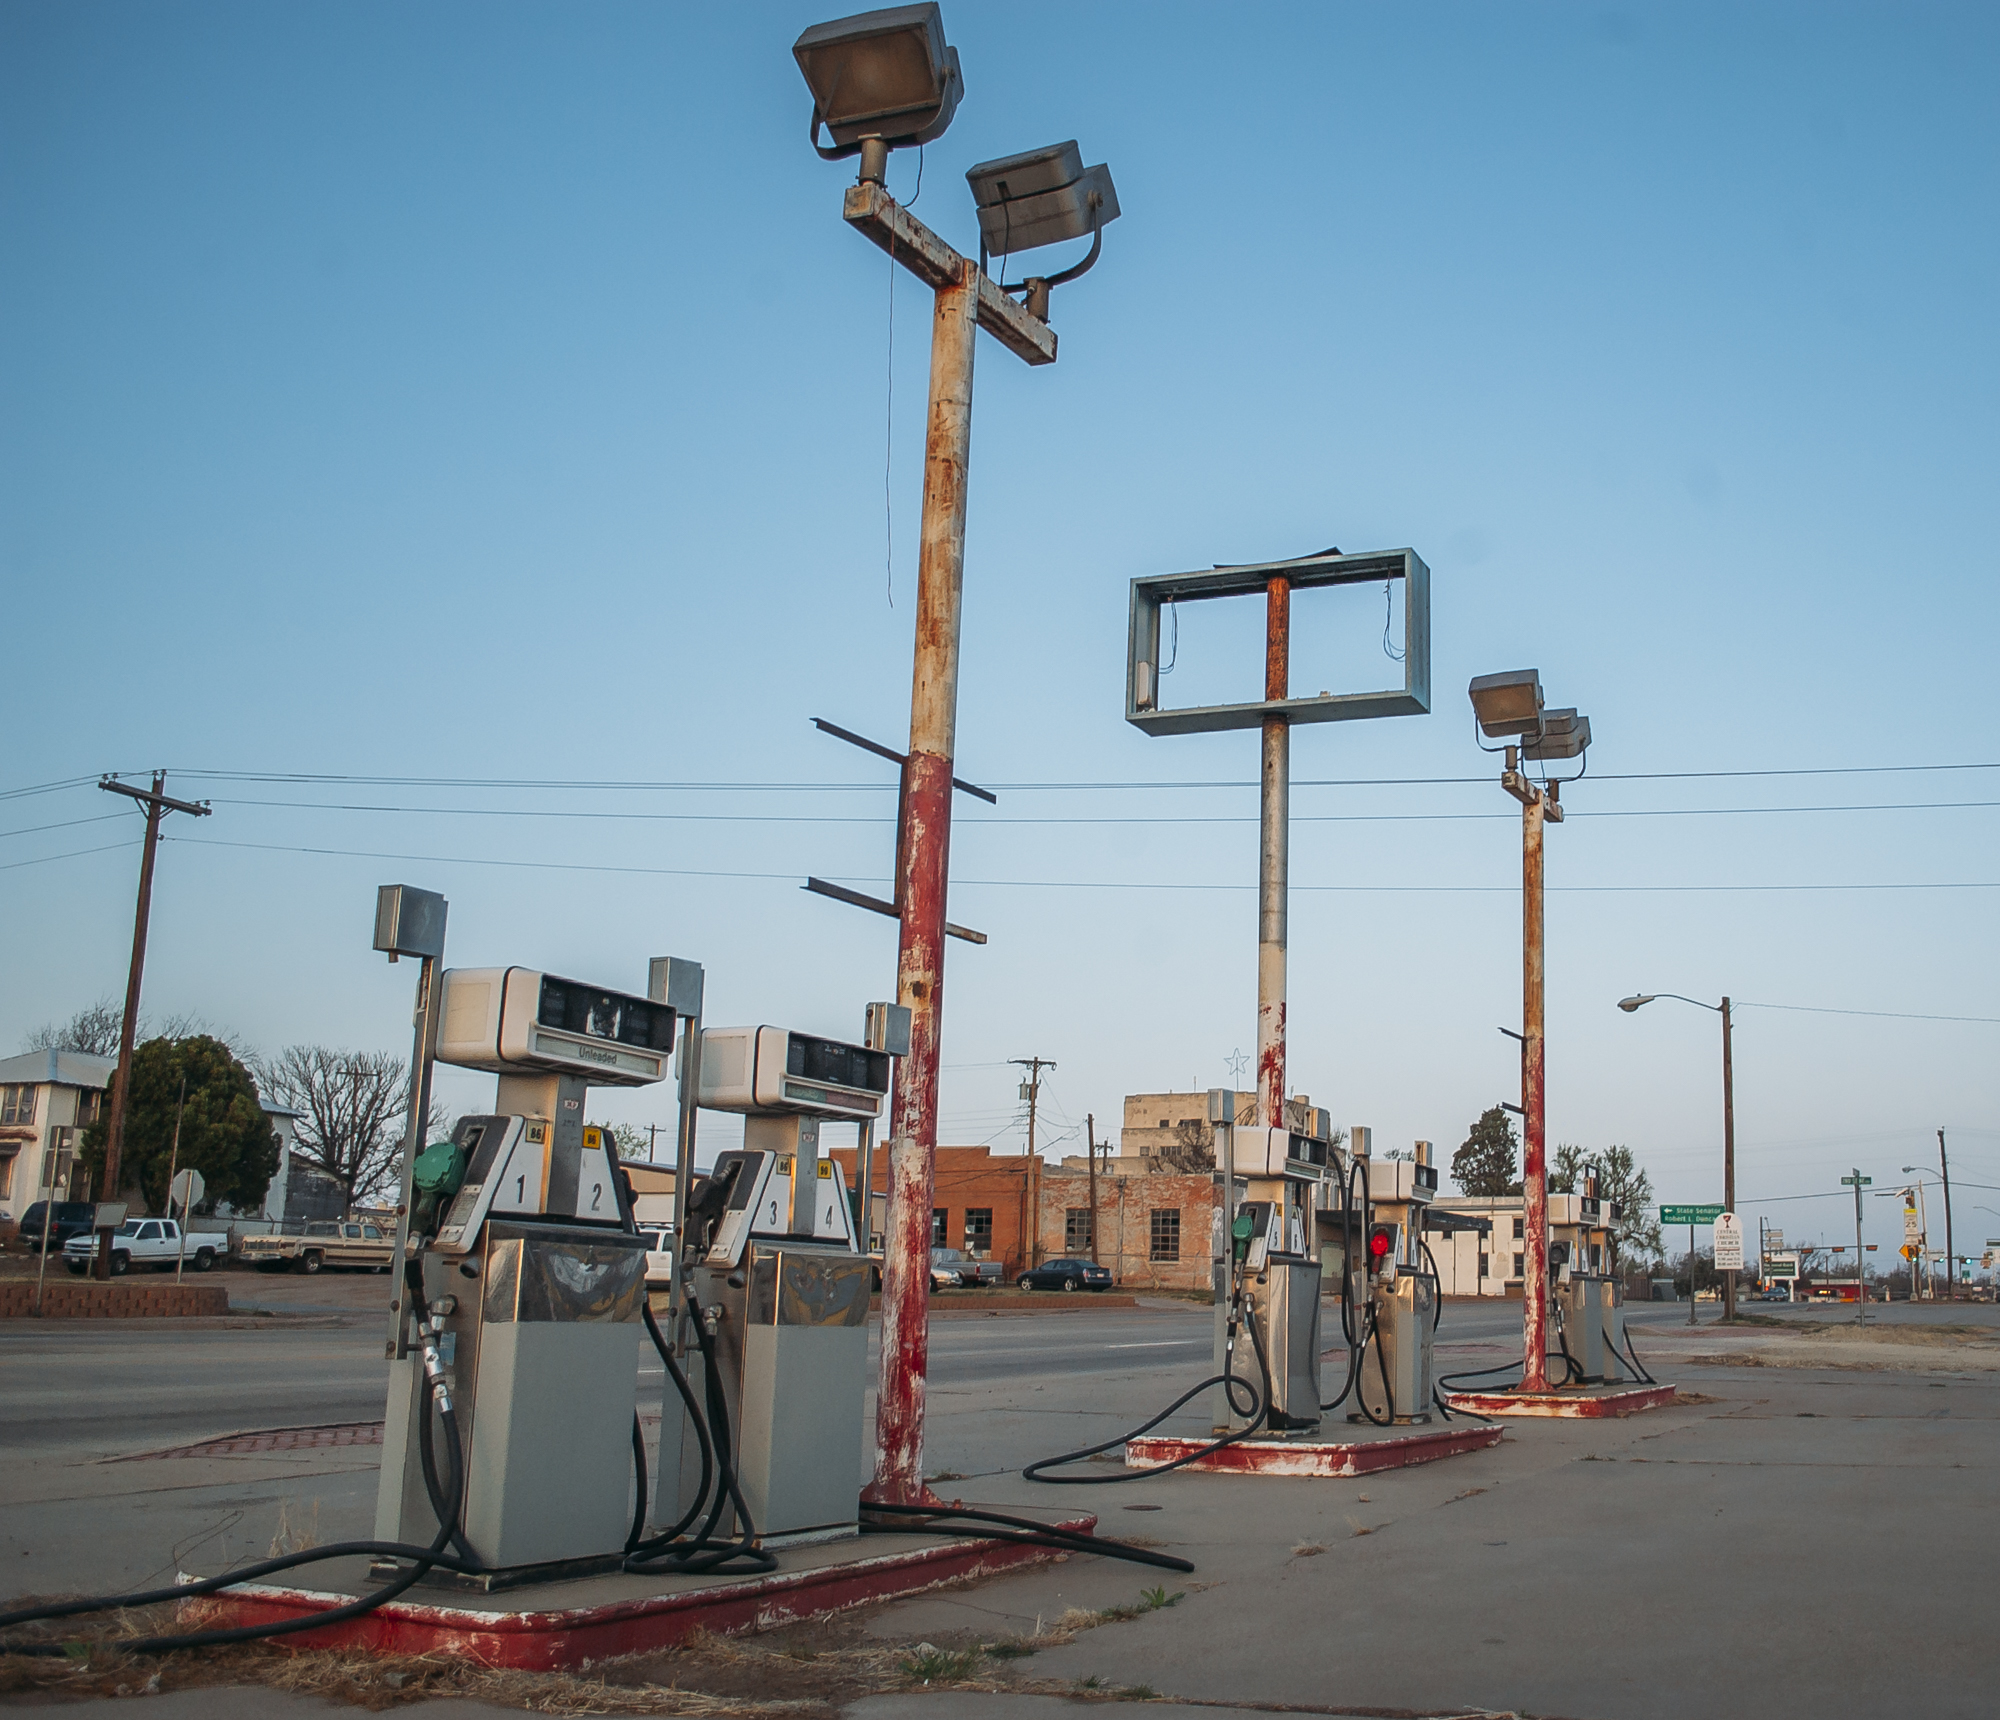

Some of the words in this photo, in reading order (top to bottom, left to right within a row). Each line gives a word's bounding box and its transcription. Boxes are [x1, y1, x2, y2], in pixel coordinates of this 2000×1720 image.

[579, 1046, 617, 1064] Unleaded
[530, 1128, 541, 1139] 86
[517, 1174, 525, 1204] 1
[591, 1183, 602, 1211] 2
[770, 1200, 777, 1225] 3
[826, 1205, 833, 1229] 4
